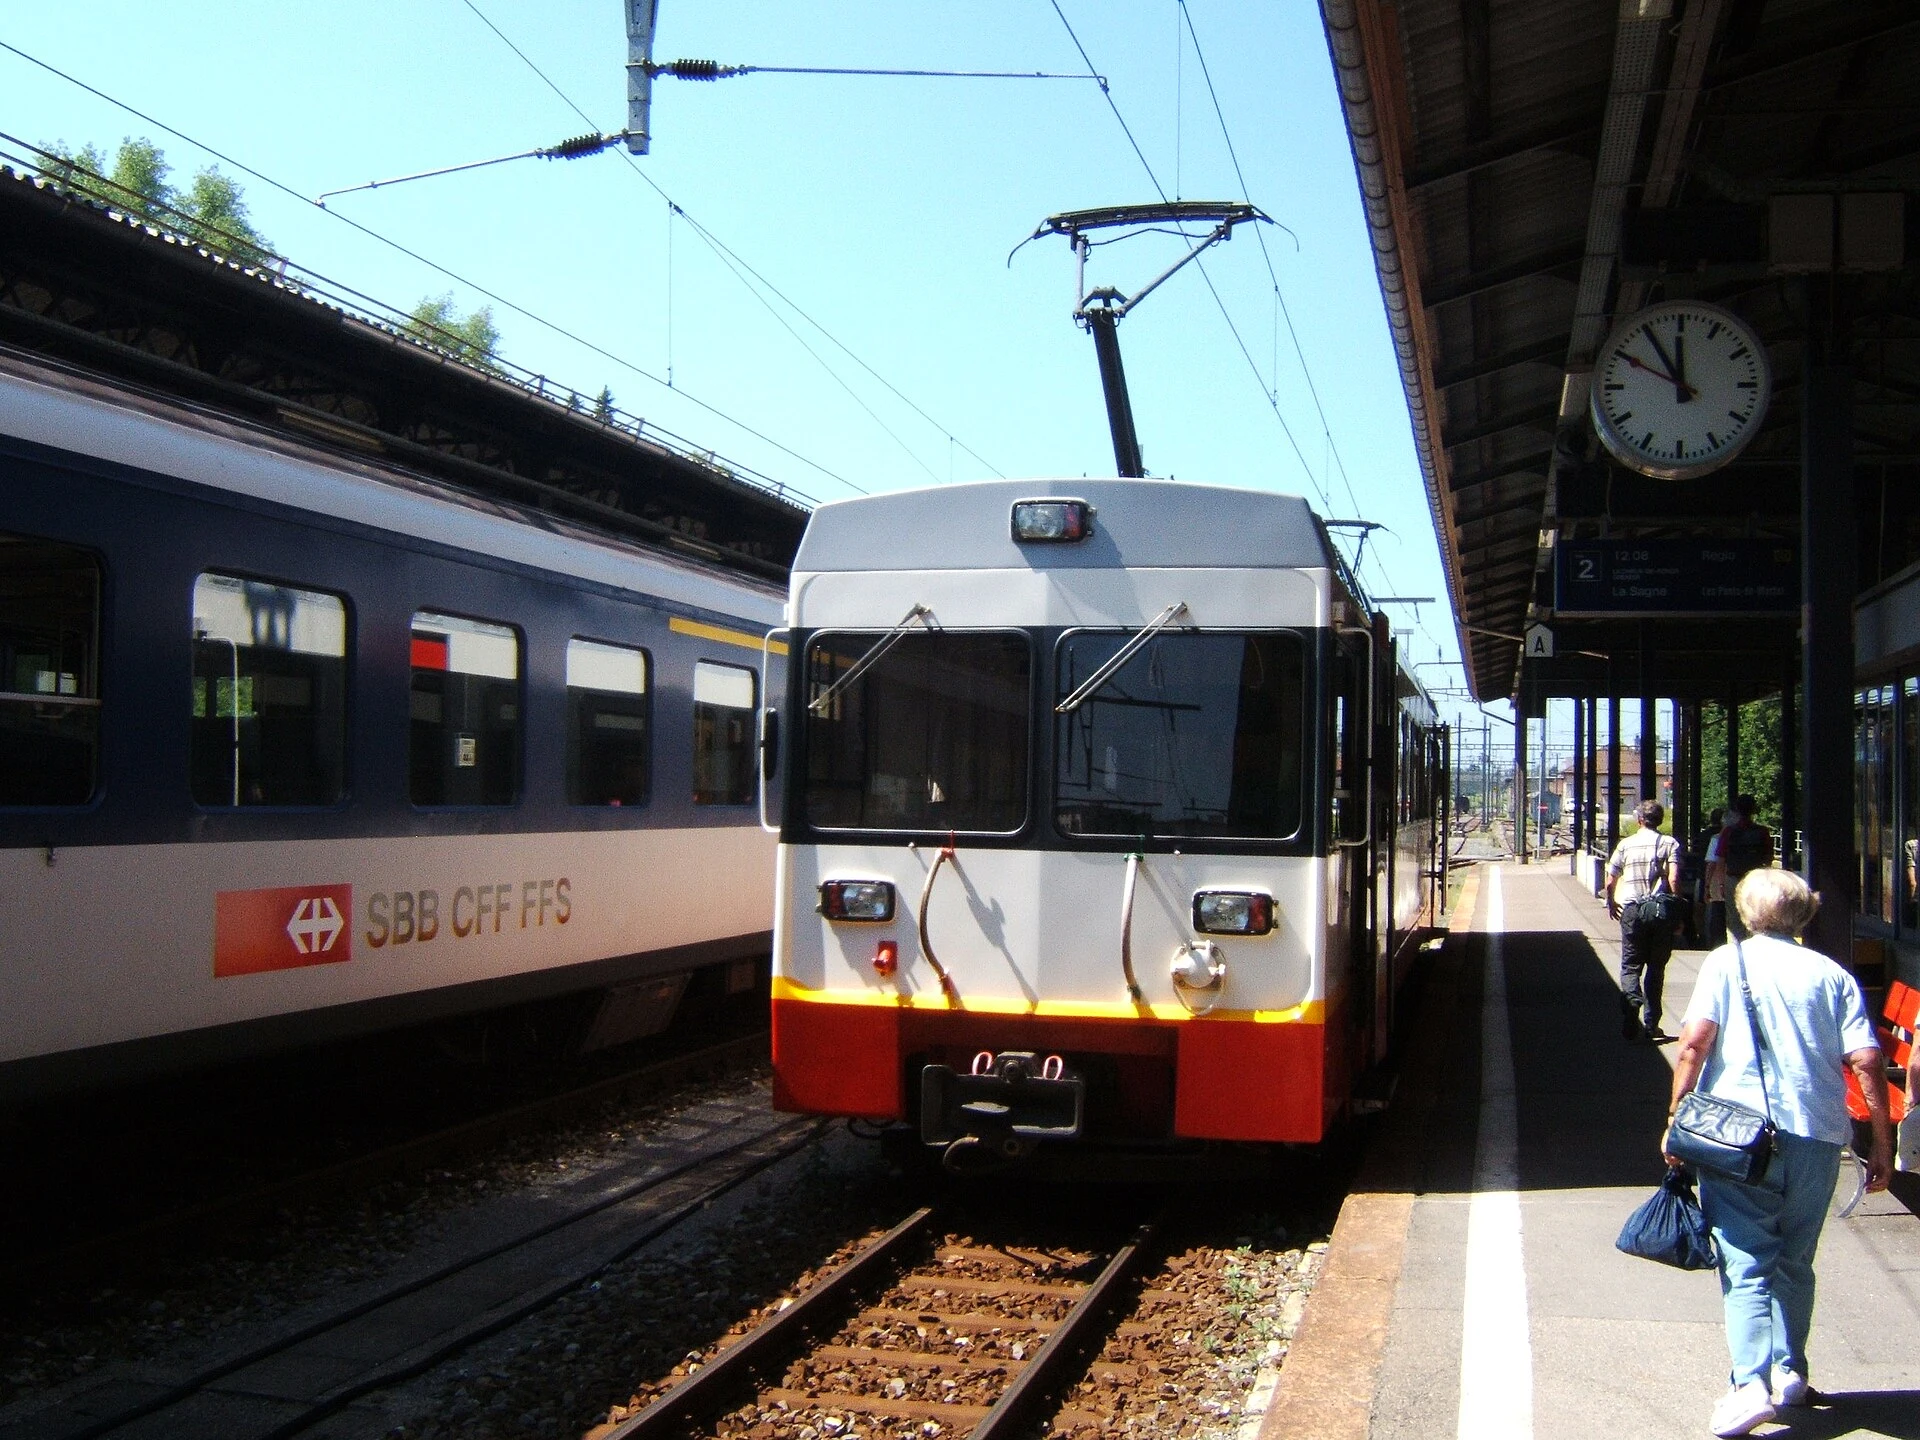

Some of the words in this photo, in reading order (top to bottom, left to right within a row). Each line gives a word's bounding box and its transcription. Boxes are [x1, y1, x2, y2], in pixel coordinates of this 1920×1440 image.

[1578, 558, 1595, 579] 2
[1534, 635, 1546, 653] A
[366, 889, 440, 948] SBB
[451, 884, 513, 939] CFF
[521, 877, 572, 929] FFS
